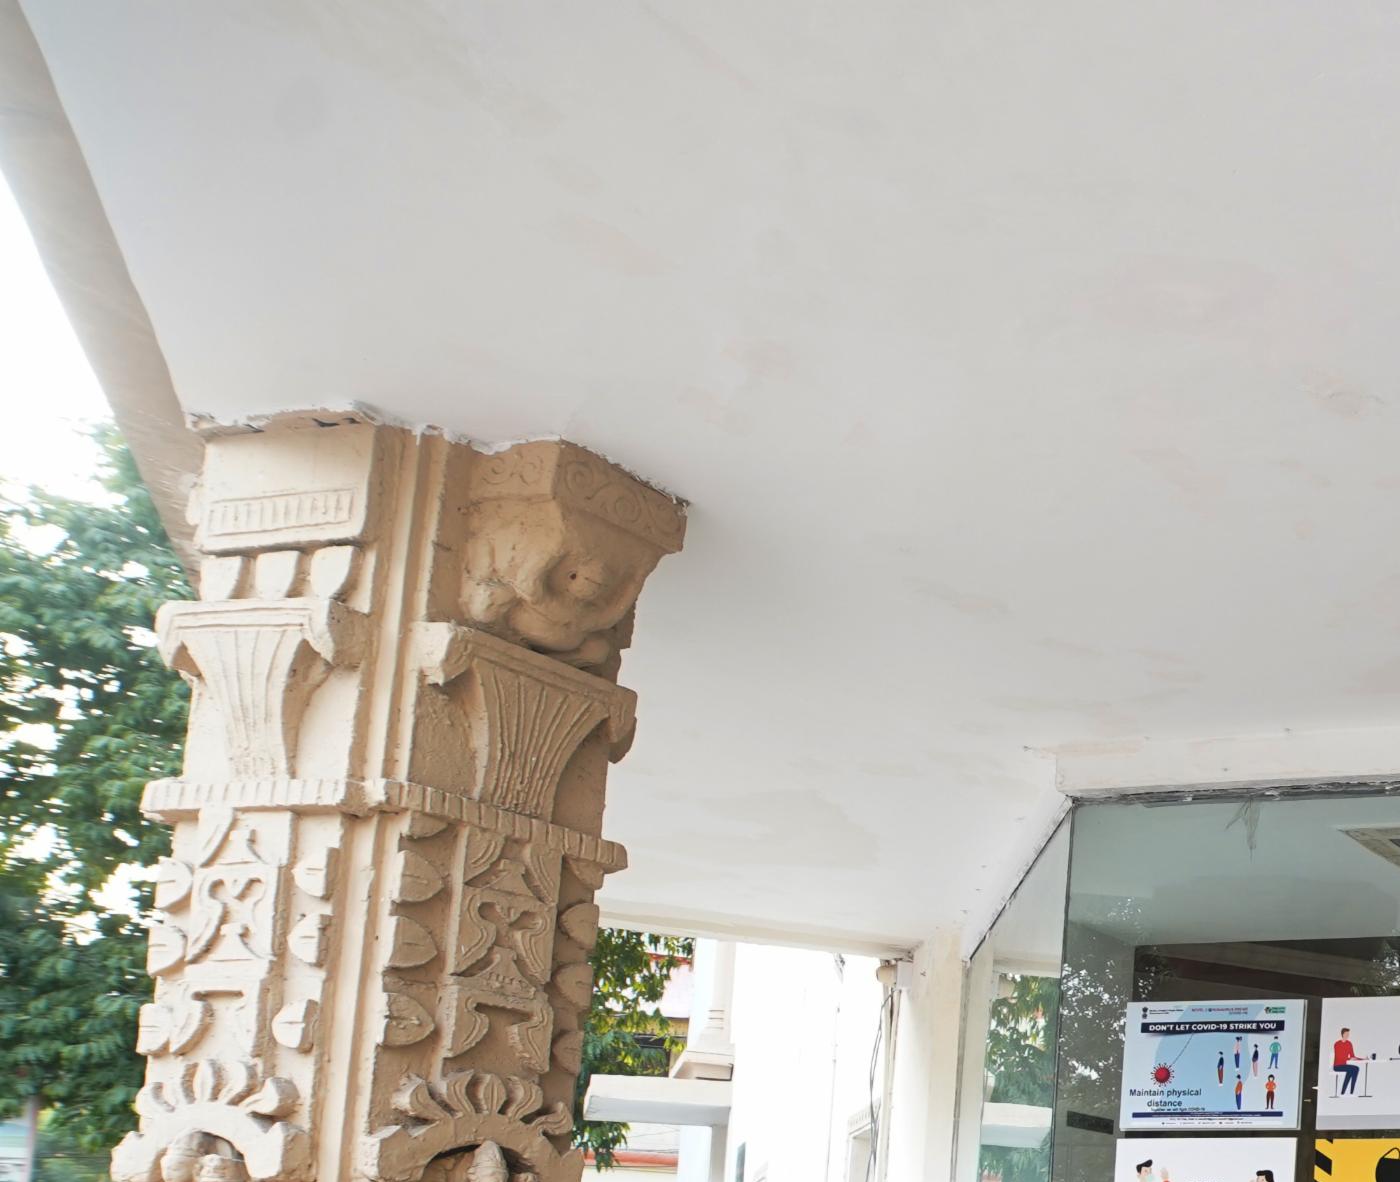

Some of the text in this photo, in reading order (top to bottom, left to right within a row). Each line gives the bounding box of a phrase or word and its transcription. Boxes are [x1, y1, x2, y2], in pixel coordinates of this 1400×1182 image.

[1149, 1022, 1277, 1032] DON'T LET COVID-19 STRIKE YOU
[1129, 1088, 1202, 1099] Maintain physical
[1147, 1099, 1183, 1107] distance
